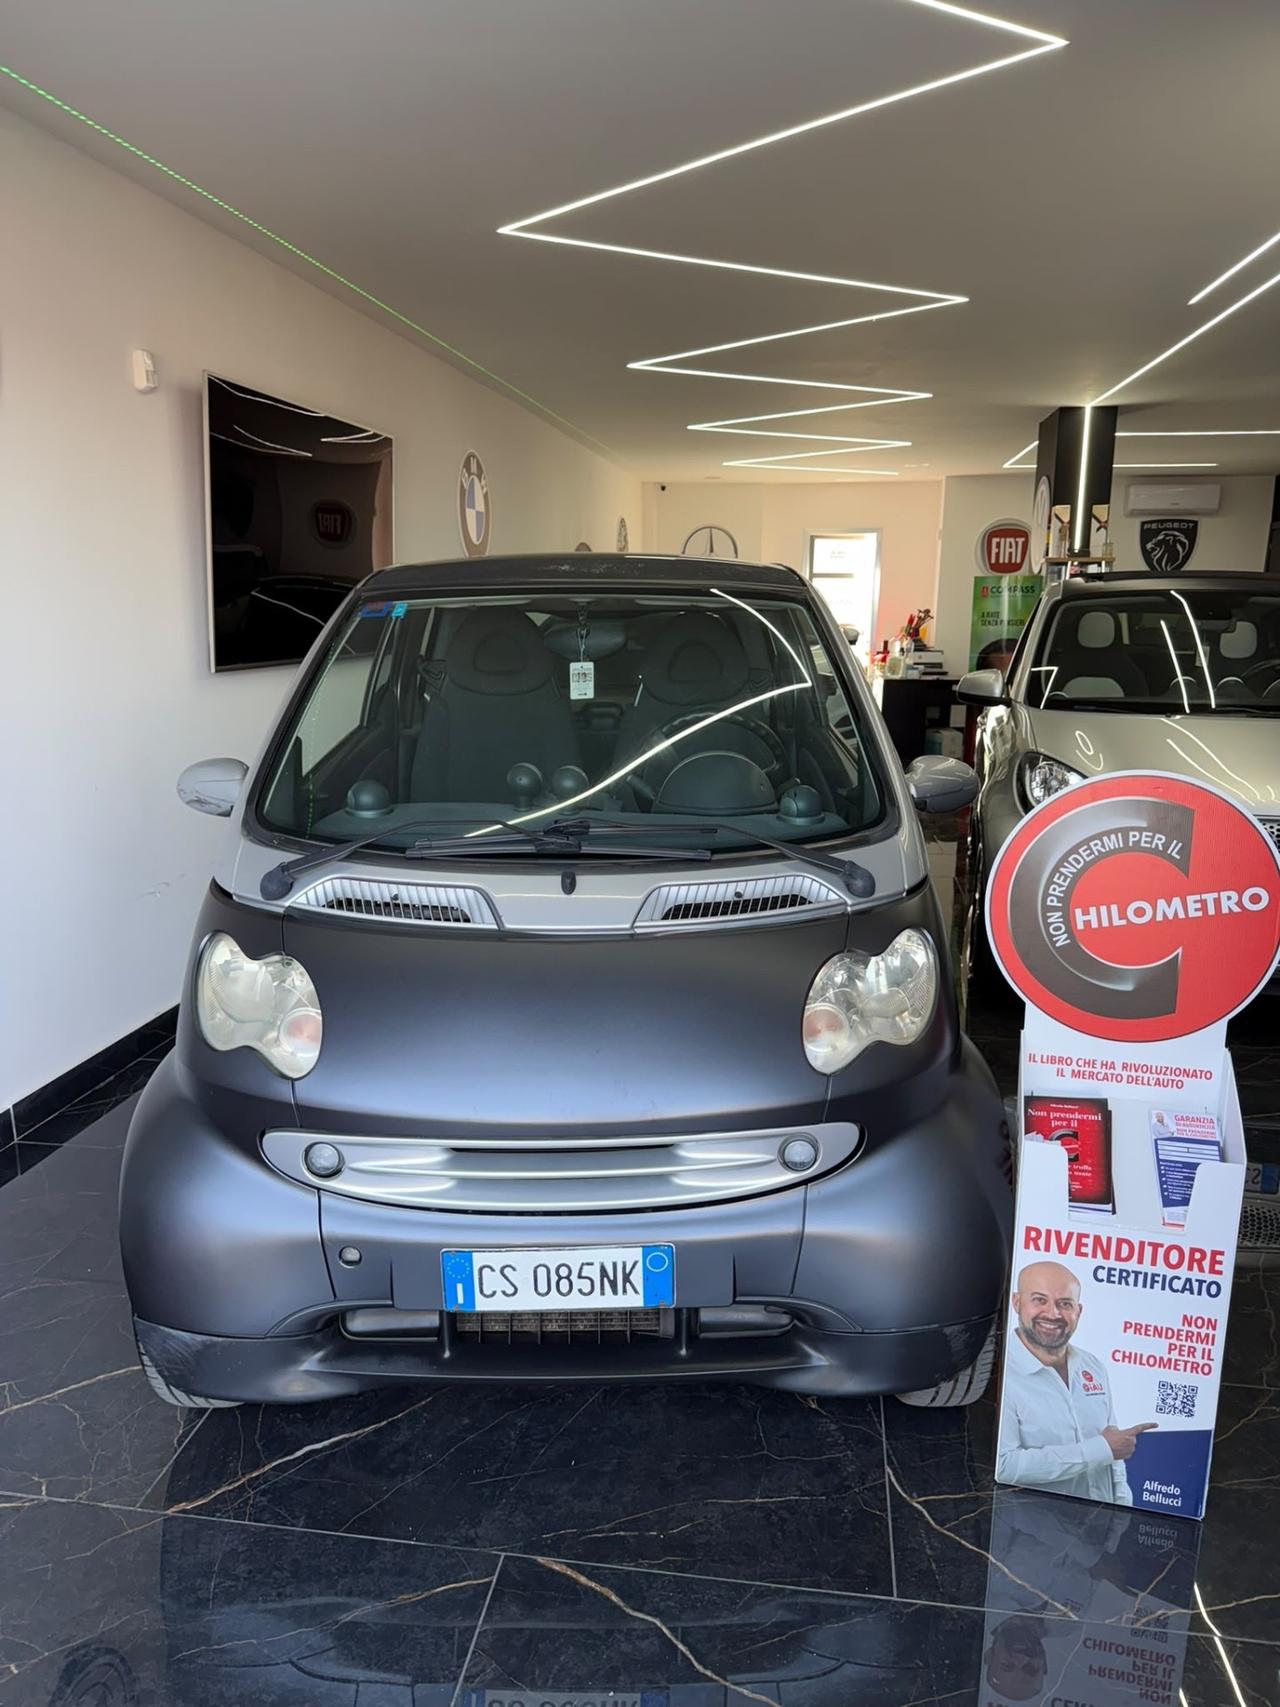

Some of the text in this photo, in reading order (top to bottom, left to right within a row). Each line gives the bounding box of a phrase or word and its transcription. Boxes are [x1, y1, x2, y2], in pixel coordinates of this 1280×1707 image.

[991, 538, 1025, 564] FIAT
[1047, 831, 1183, 948] NON PRENDERMI PER IL
[1028, 1053, 1213, 1081] IL LIBRO CHE HA RIVOLUZIONATO
[1056, 1066, 1184, 1090] IL MERCATO DELL'AUTO
[1028, 1108, 1102, 1121] Non prendermi
[1051, 1120, 1068, 1128] per
[1174, 1114, 1215, 1124] GARANZIA
[1023, 1225, 1226, 1276] RIVENDITORE
[478, 1260, 640, 1298] CS 085NK
[1093, 1265, 1222, 1299] CERTIFICATO
[1123, 1320, 1216, 1347] PRENDERMI
[1182, 1314, 1218, 1331] NON
[1112, 1349, 1213, 1376] CHILOMETRO
[1167, 1343, 1215, 1362] PER IL
[1142, 1492, 1182, 1507] Bellucci
[1143, 1480, 1181, 1496] Alfredo
